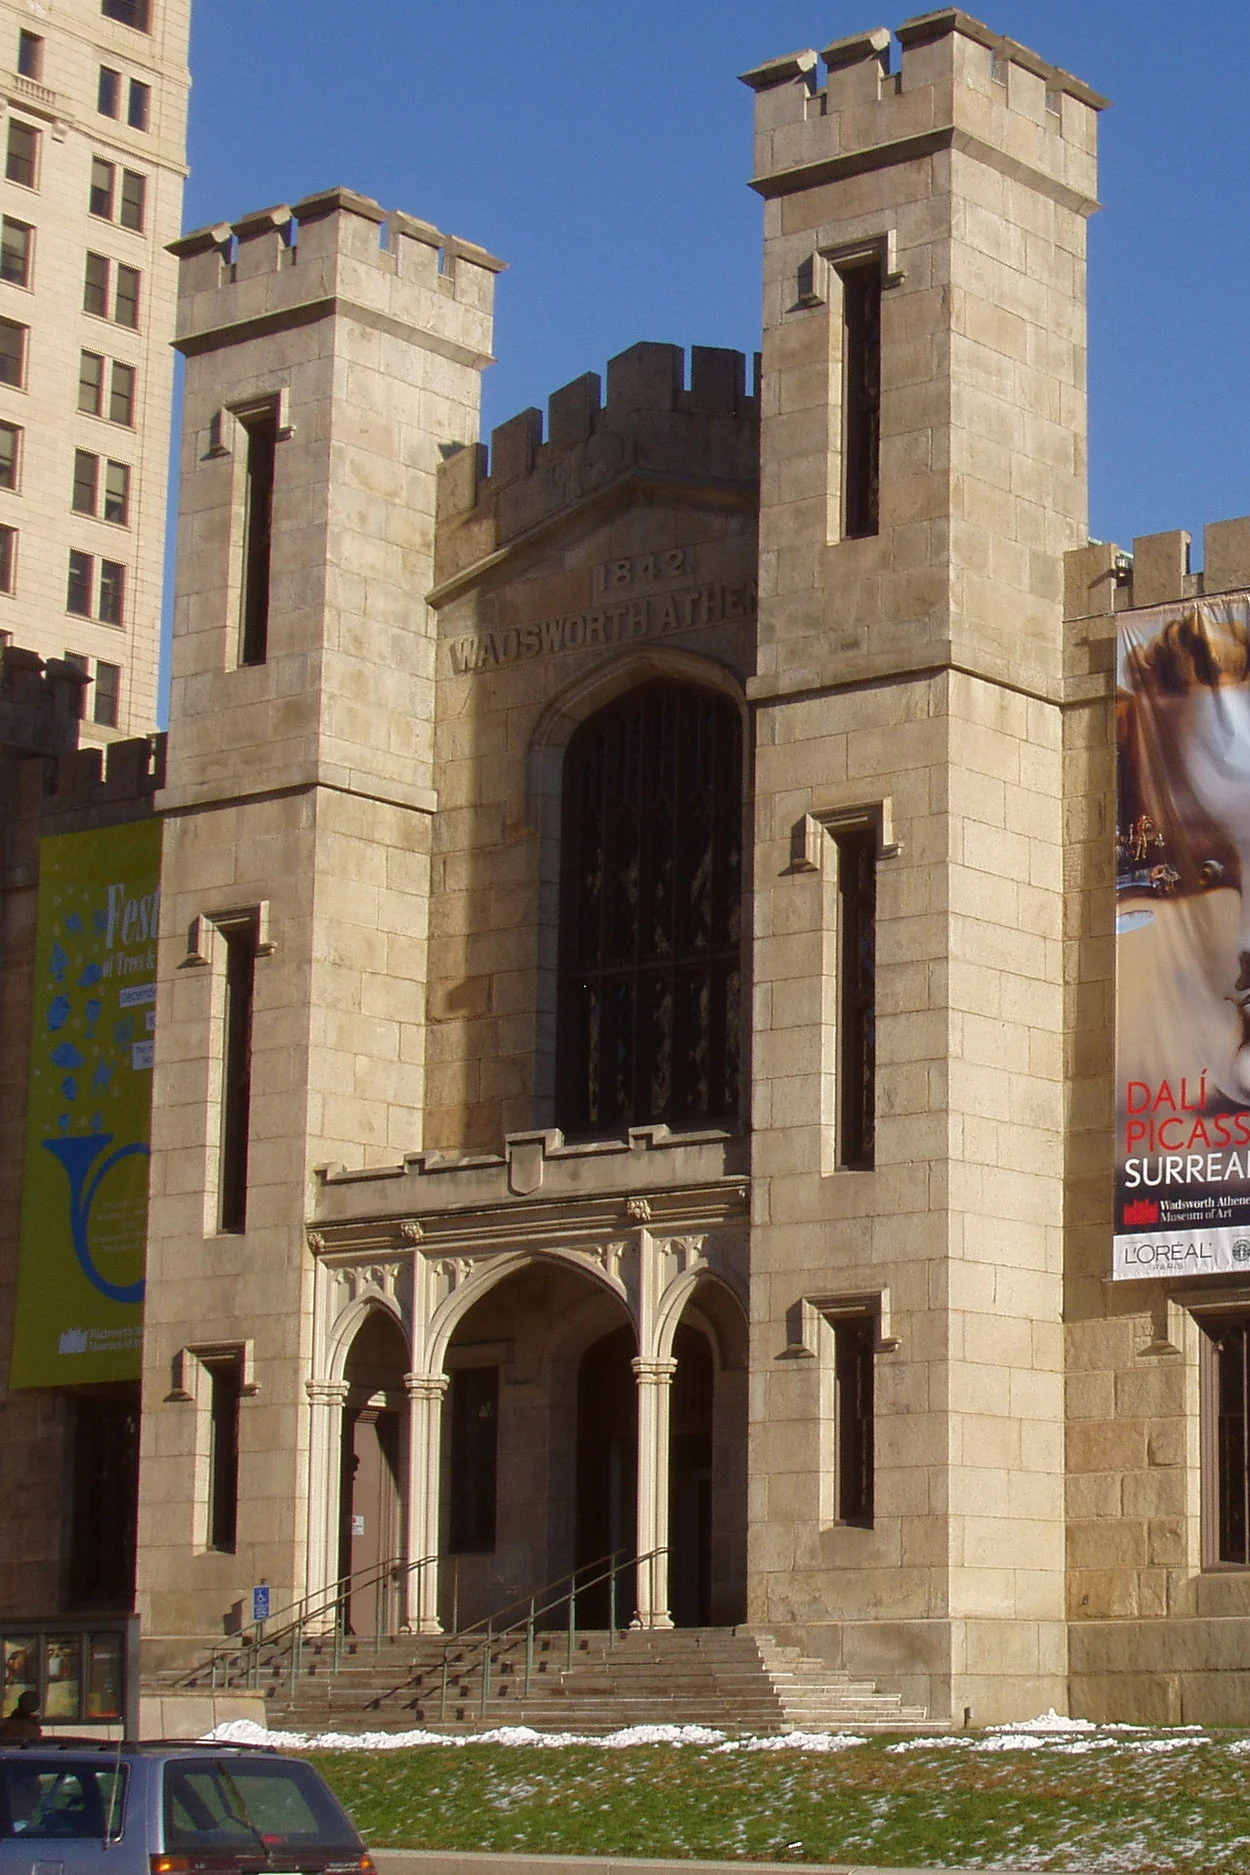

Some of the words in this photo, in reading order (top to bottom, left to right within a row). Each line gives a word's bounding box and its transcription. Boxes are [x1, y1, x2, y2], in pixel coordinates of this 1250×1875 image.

[449, 600, 643, 675] WADSWORTH
[1125, 1068, 1208, 1115] DALÍ
[1160, 1197, 1215, 1211] Wadsworth
[1160, 1210, 1204, 1223] Museum
[1205, 1209, 1216, 1220] of
[1218, 1207, 1233, 1219] Art
